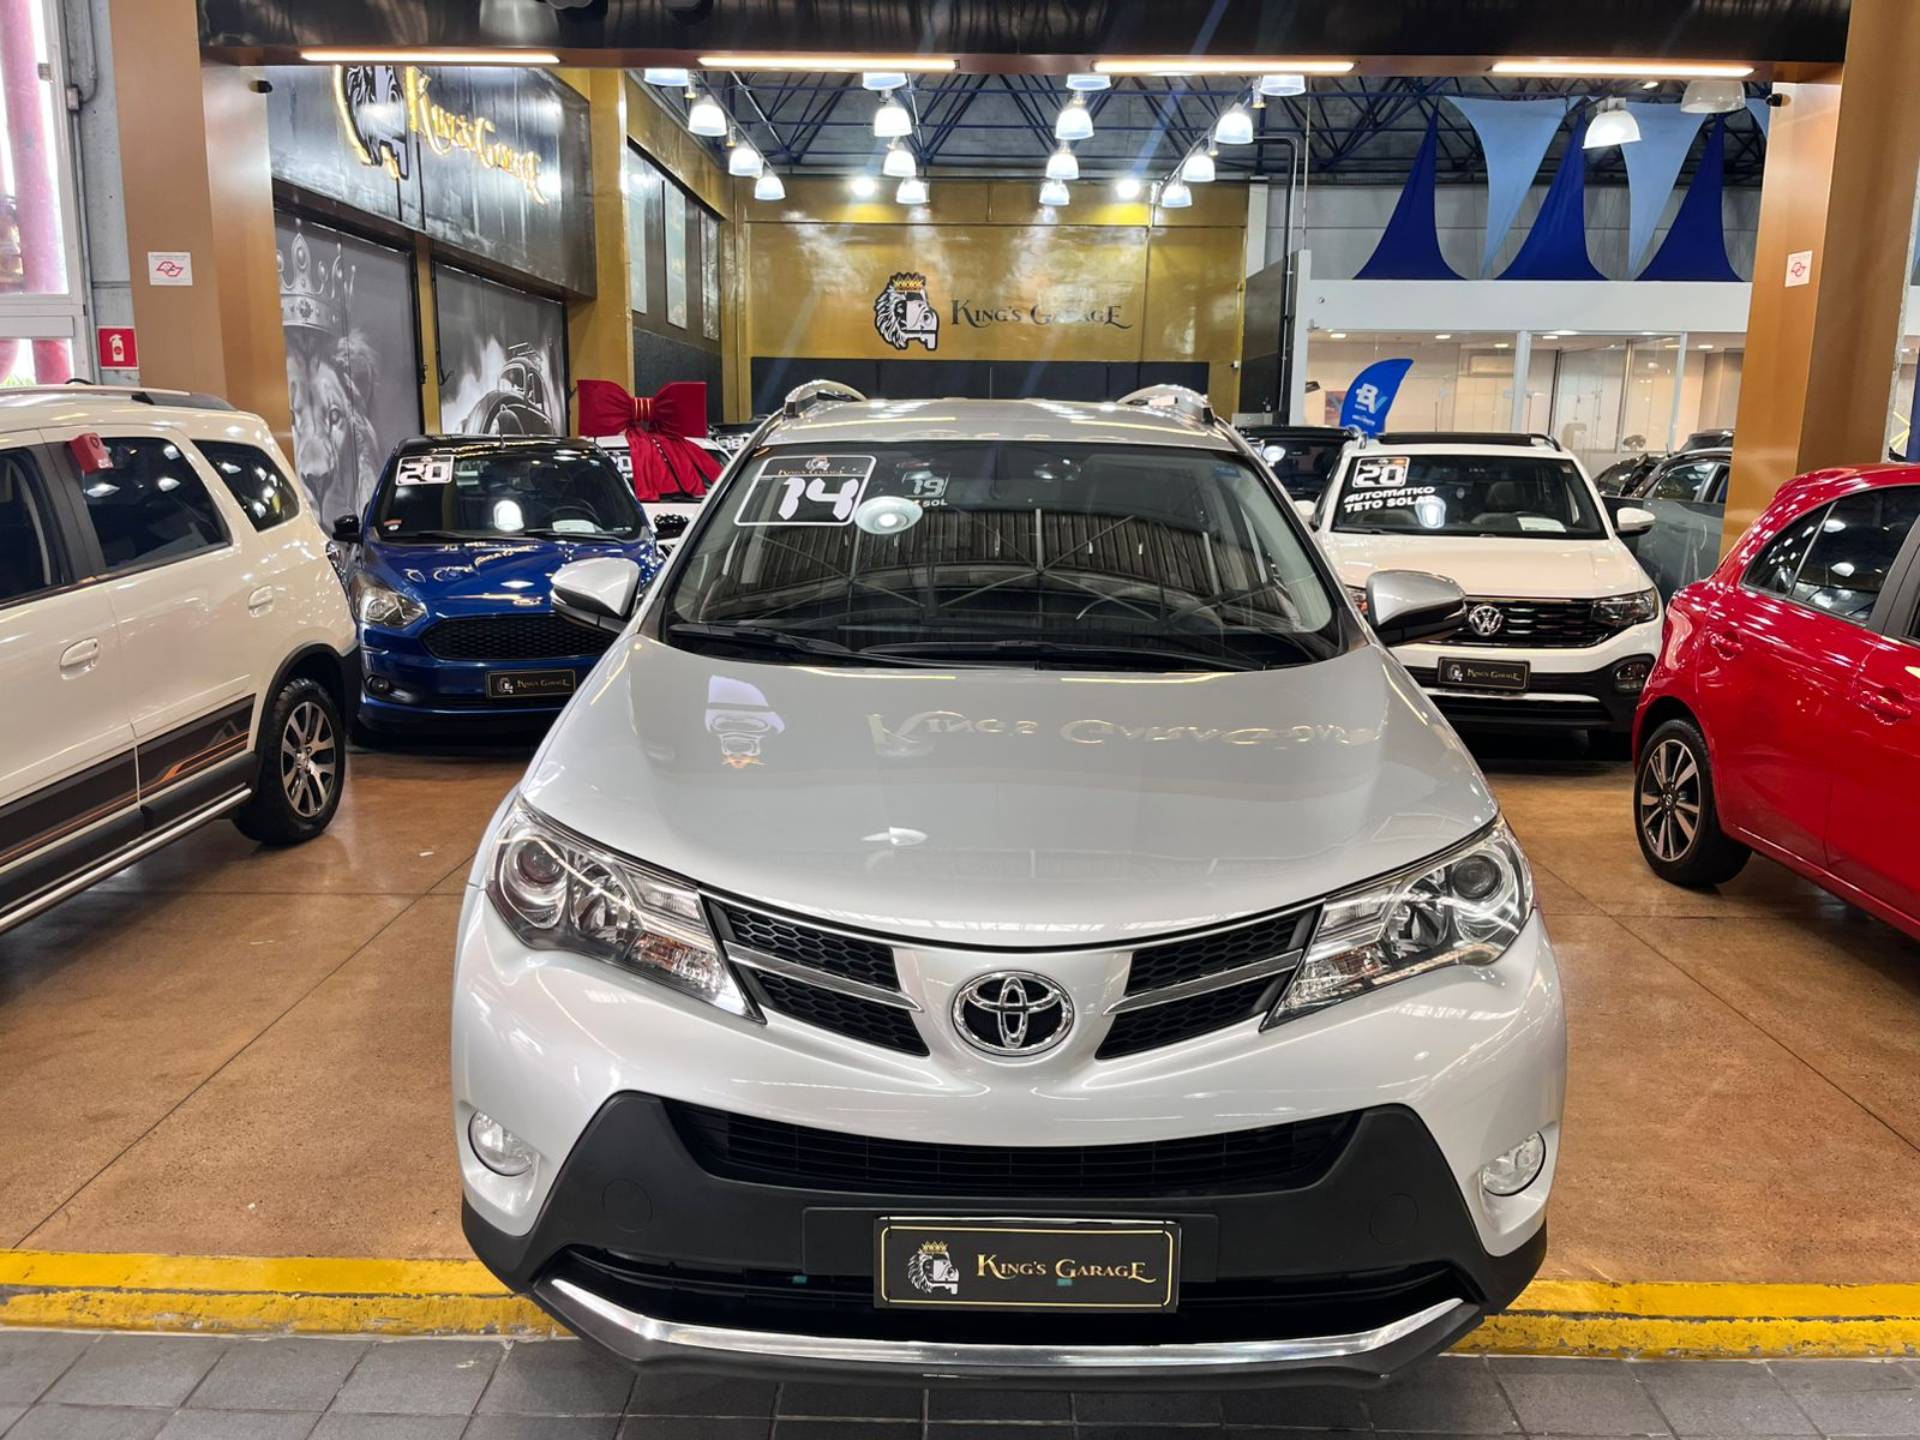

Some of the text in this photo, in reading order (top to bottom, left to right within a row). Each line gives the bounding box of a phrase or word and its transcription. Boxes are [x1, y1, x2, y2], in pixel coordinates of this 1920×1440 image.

[951, 299, 1021, 328] KING'S
[400, 462, 450, 482] 20
[1356, 465, 1404, 485] 20
[913, 477, 944, 496] 19
[778, 478, 860, 520] 14
[1344, 500, 1384, 513] TETO
[976, 1253, 1156, 1284] KING'S GARAGE
